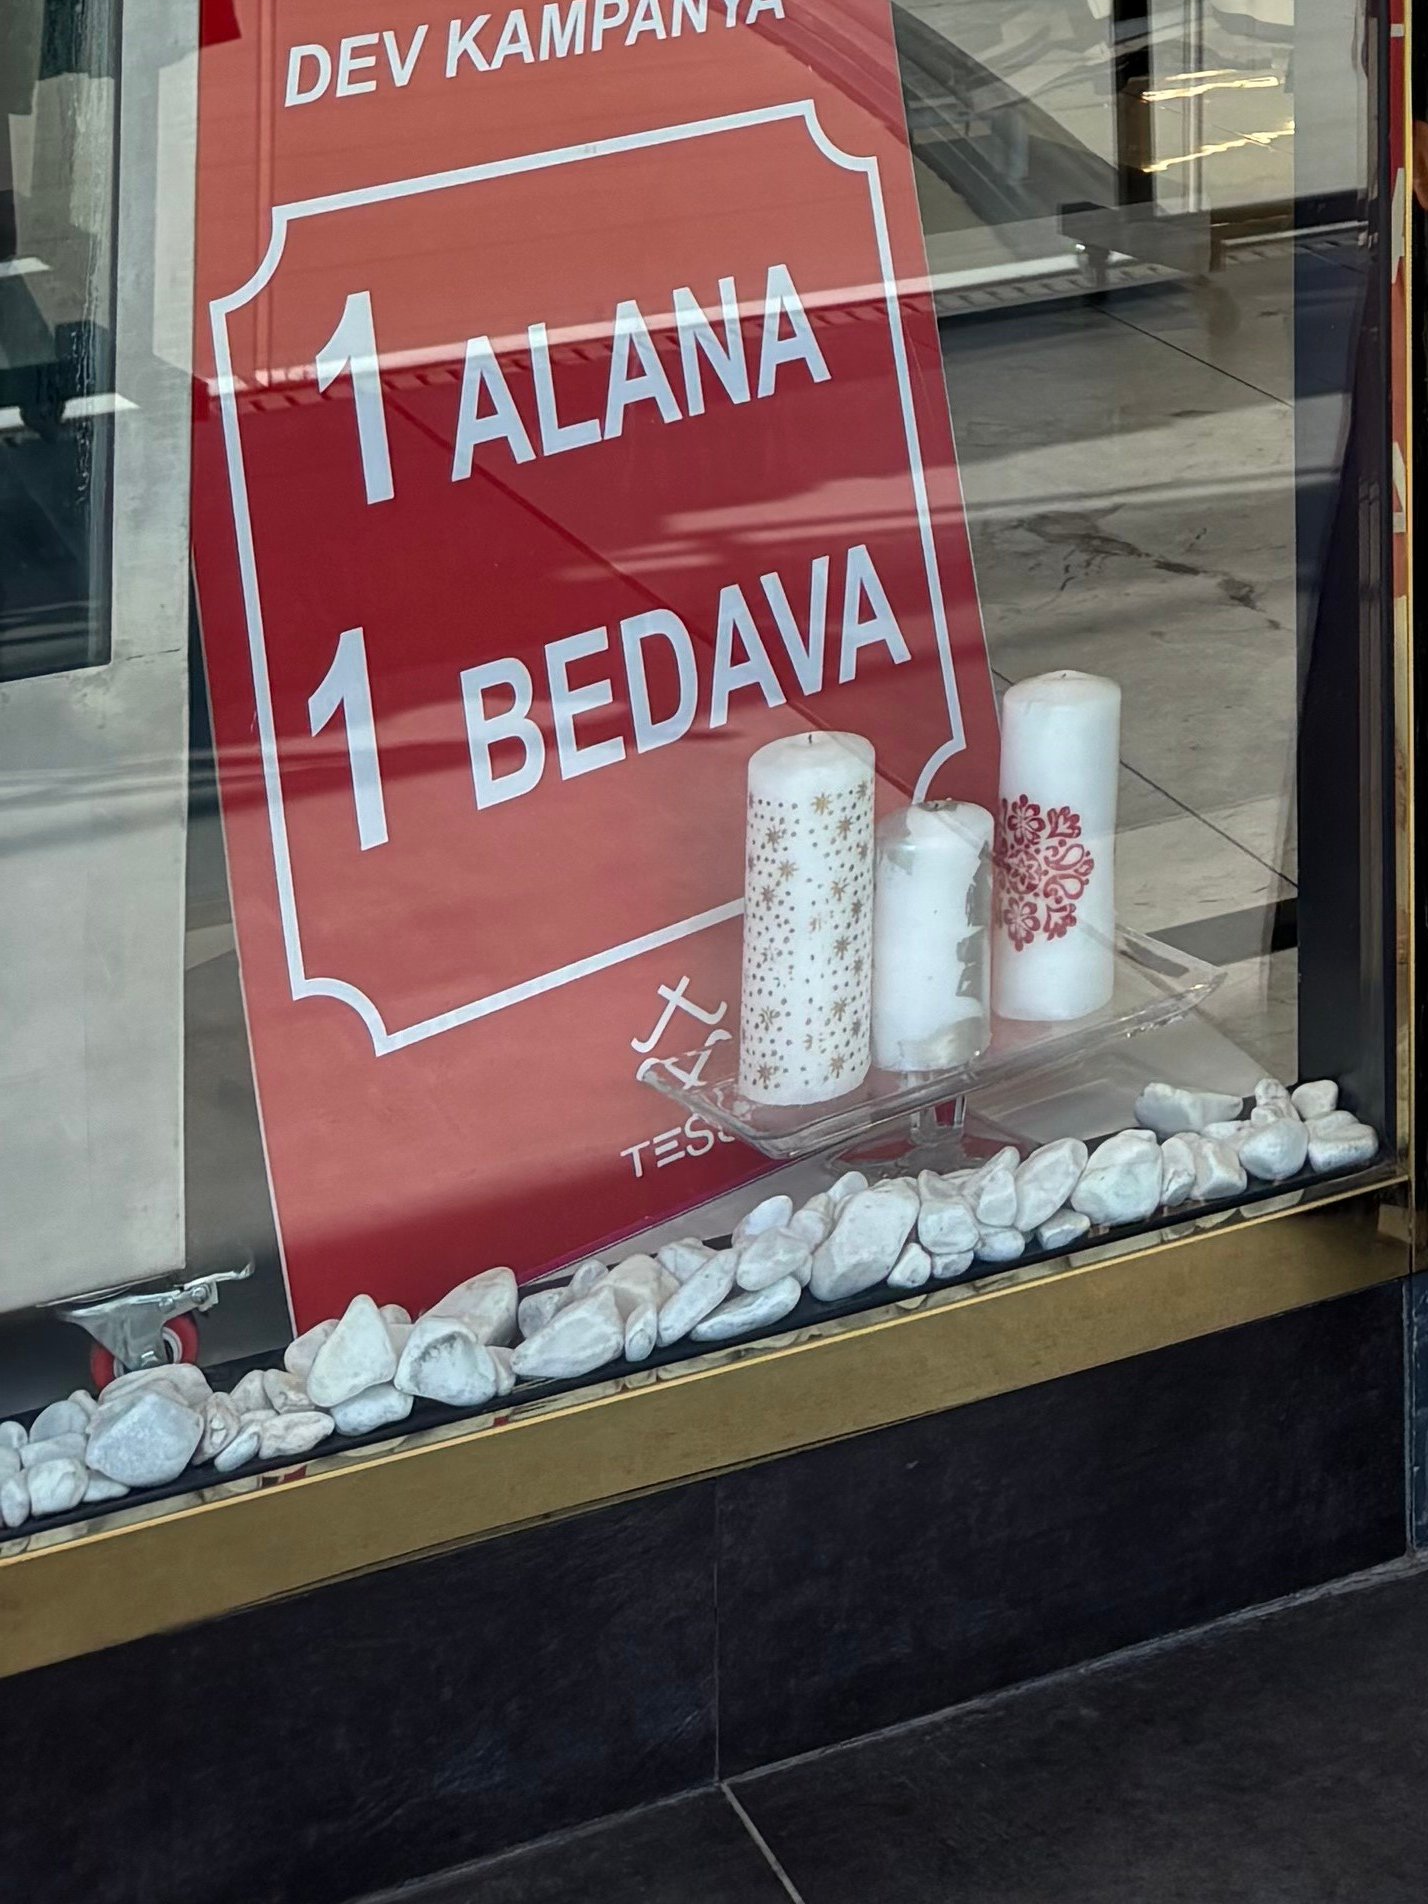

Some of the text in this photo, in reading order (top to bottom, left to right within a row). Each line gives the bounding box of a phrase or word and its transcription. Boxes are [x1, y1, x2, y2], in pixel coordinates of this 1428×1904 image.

[284, 24, 429, 108] DEV
[315, 264, 831, 505] 1 ALANA
[307, 543, 913, 852] 1 BEDAVA
[620, 1113, 736, 1179] TES
